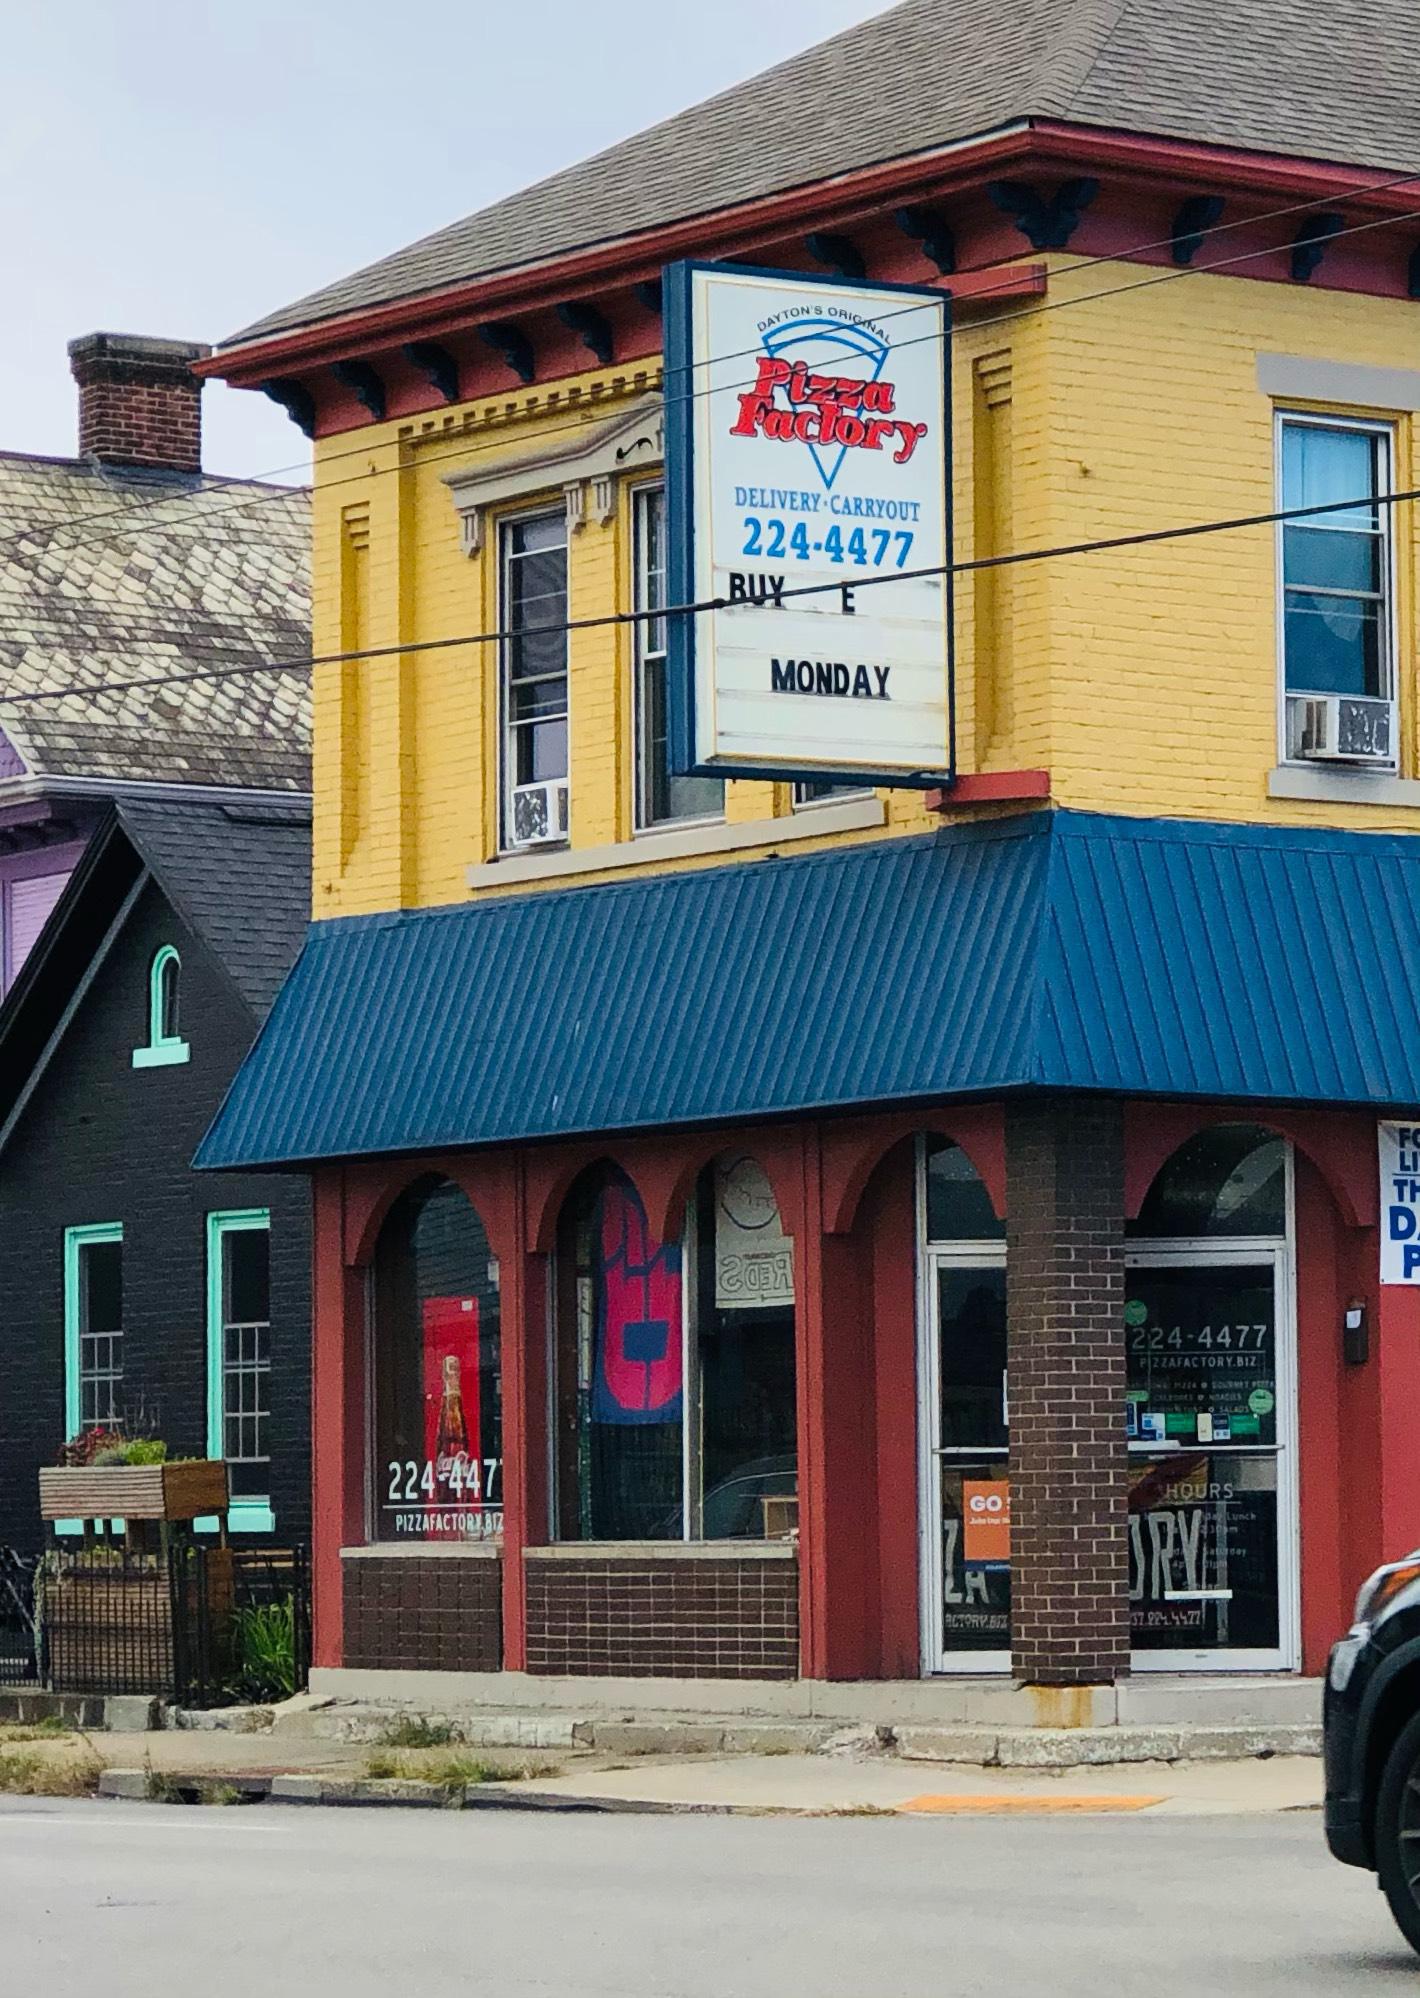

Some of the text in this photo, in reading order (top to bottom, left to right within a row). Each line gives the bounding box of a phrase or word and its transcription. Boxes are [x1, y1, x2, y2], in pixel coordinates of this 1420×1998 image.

[757, 304, 892, 345] DAYTON'S ORIGINAL
[750, 356, 896, 414] Pizza
[730, 394, 928, 464] Factory
[734, 487, 921, 522] DELIVERY CARRYOUT
[729, 572, 856, 616] BUY E
[770, 658, 891, 699] MONDAY
[1131, 1324, 1267, 1349] 224-4477
[388, 1458, 503, 1500] 224-447
[1166, 1483, 1234, 1499] HOURS
[395, 1513, 503, 1532] PIZZAFACTORY.BIZ
[969, 1495, 1003, 1513] GO
